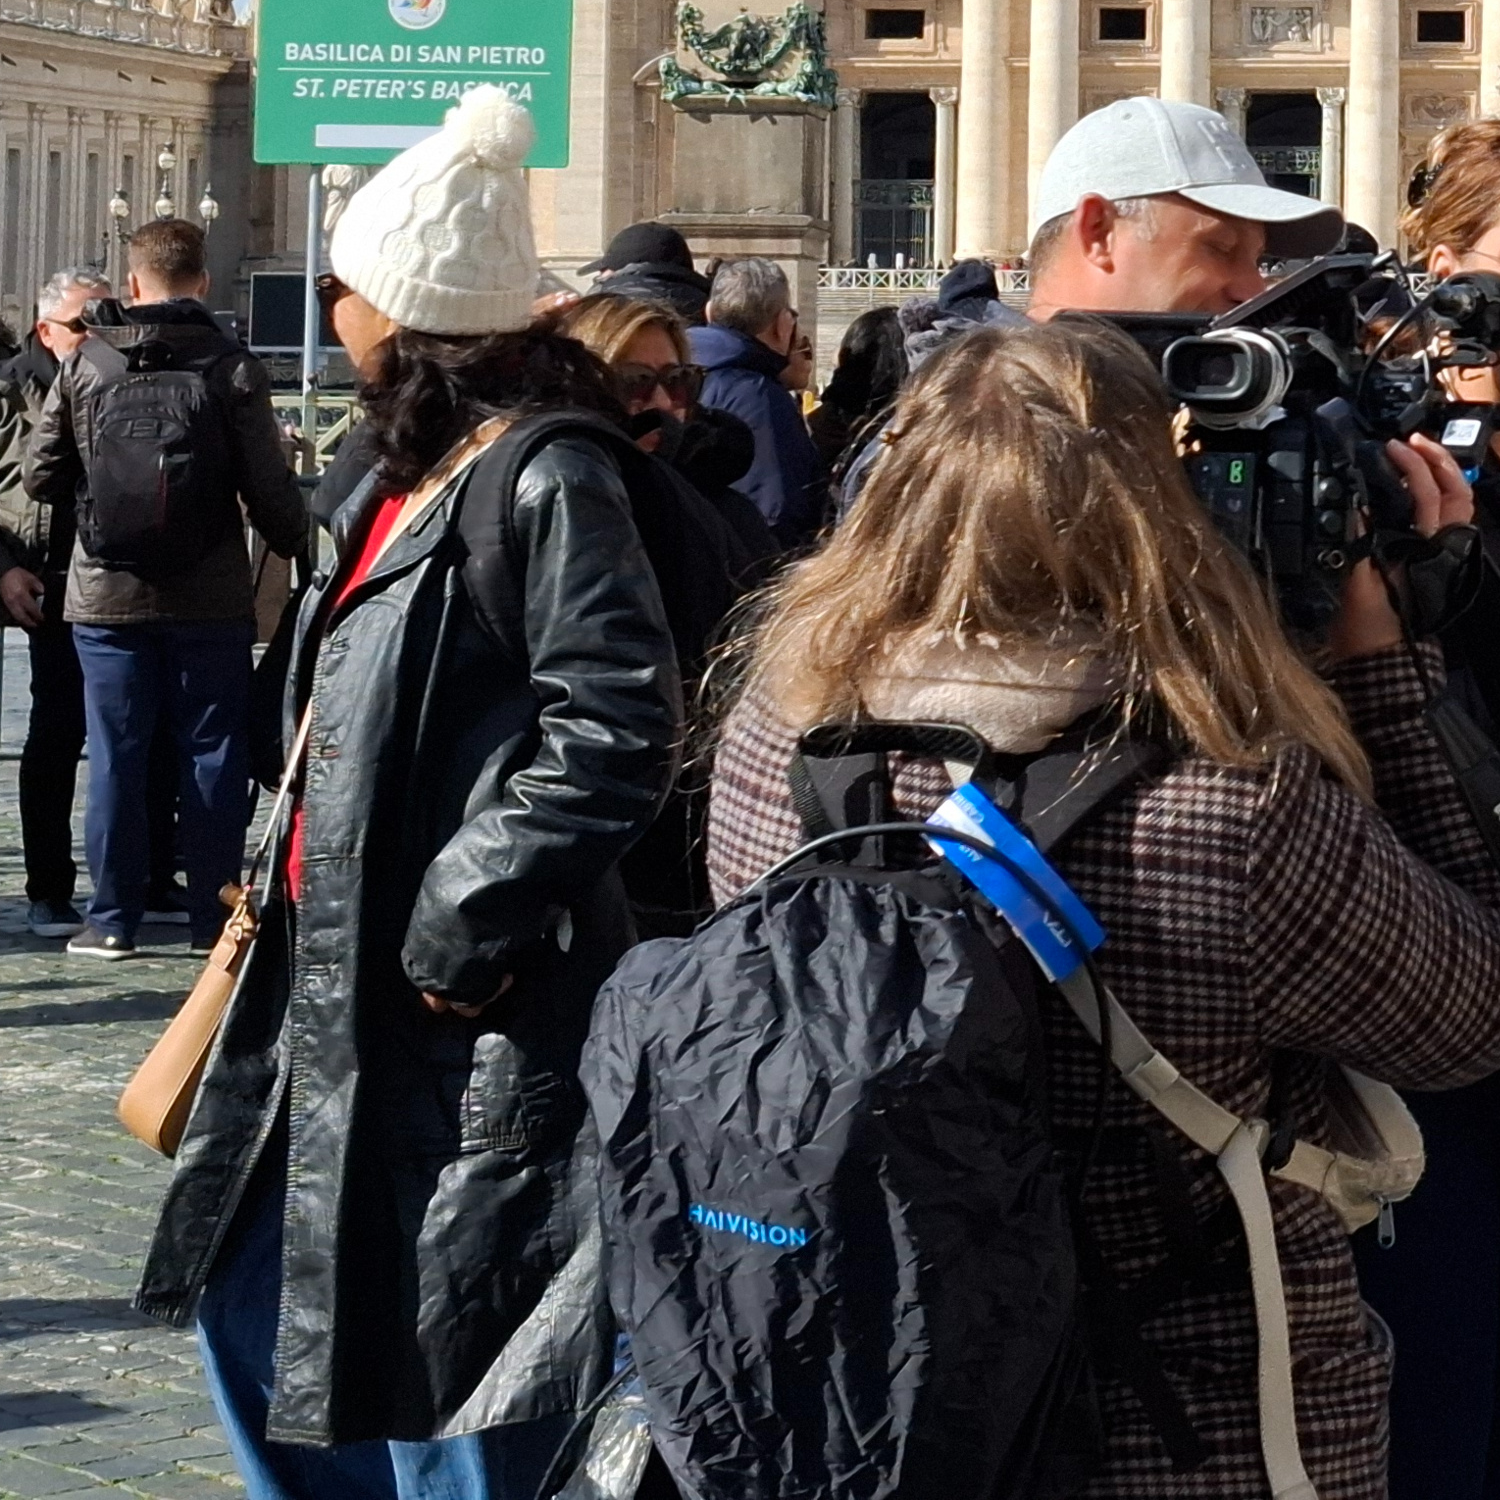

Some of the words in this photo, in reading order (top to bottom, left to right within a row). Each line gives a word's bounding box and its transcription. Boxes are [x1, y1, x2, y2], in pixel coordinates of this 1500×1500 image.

[284, 43, 383, 63] BASILICA
[391, 45, 411, 63] DI
[418, 45, 461, 64] SAN
[468, 46, 546, 65] PIETRO
[293, 78, 325, 98] ST.
[332, 79, 425, 99] PETER'S
